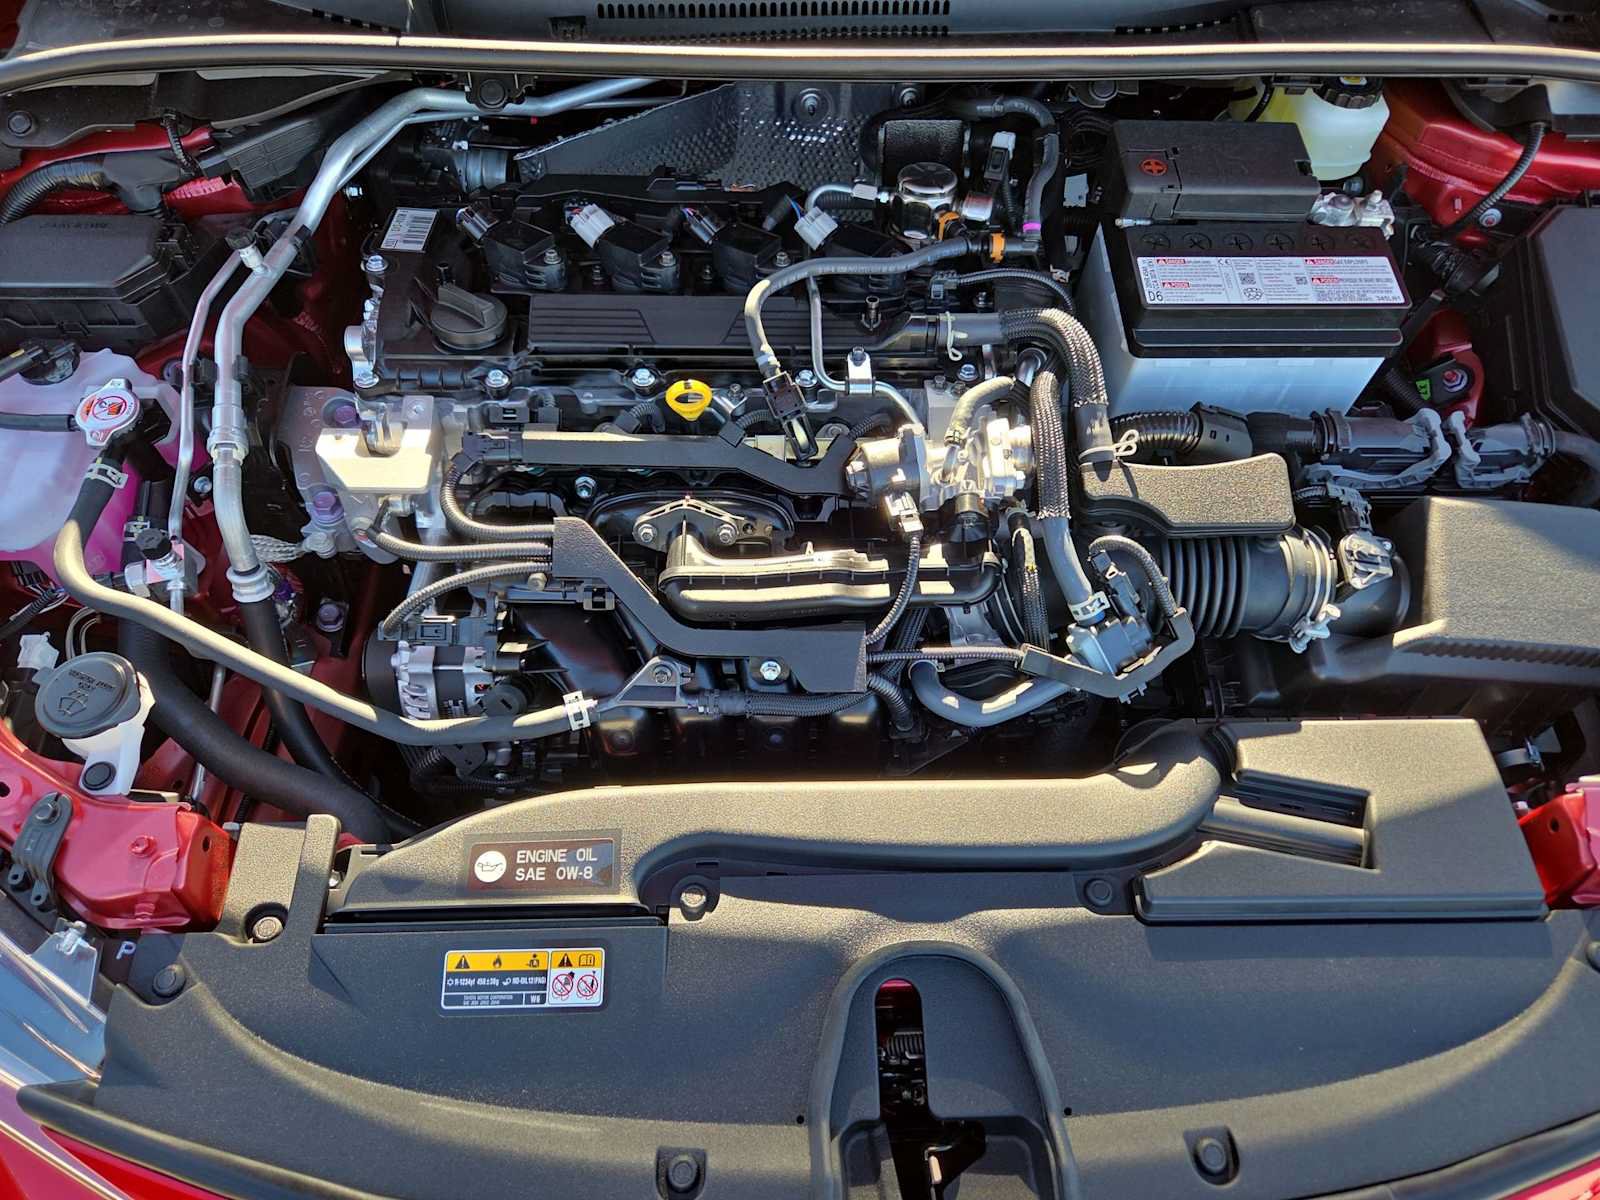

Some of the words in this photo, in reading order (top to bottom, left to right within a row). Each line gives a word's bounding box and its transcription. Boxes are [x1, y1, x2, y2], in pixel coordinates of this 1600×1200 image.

[1149, 291, 1163, 301] D6
[516, 848, 568, 864] ENGINE
[575, 847, 598, 862] OIL
[514, 867, 546, 881] SAE
[556, 866, 593, 880] 0W-8
